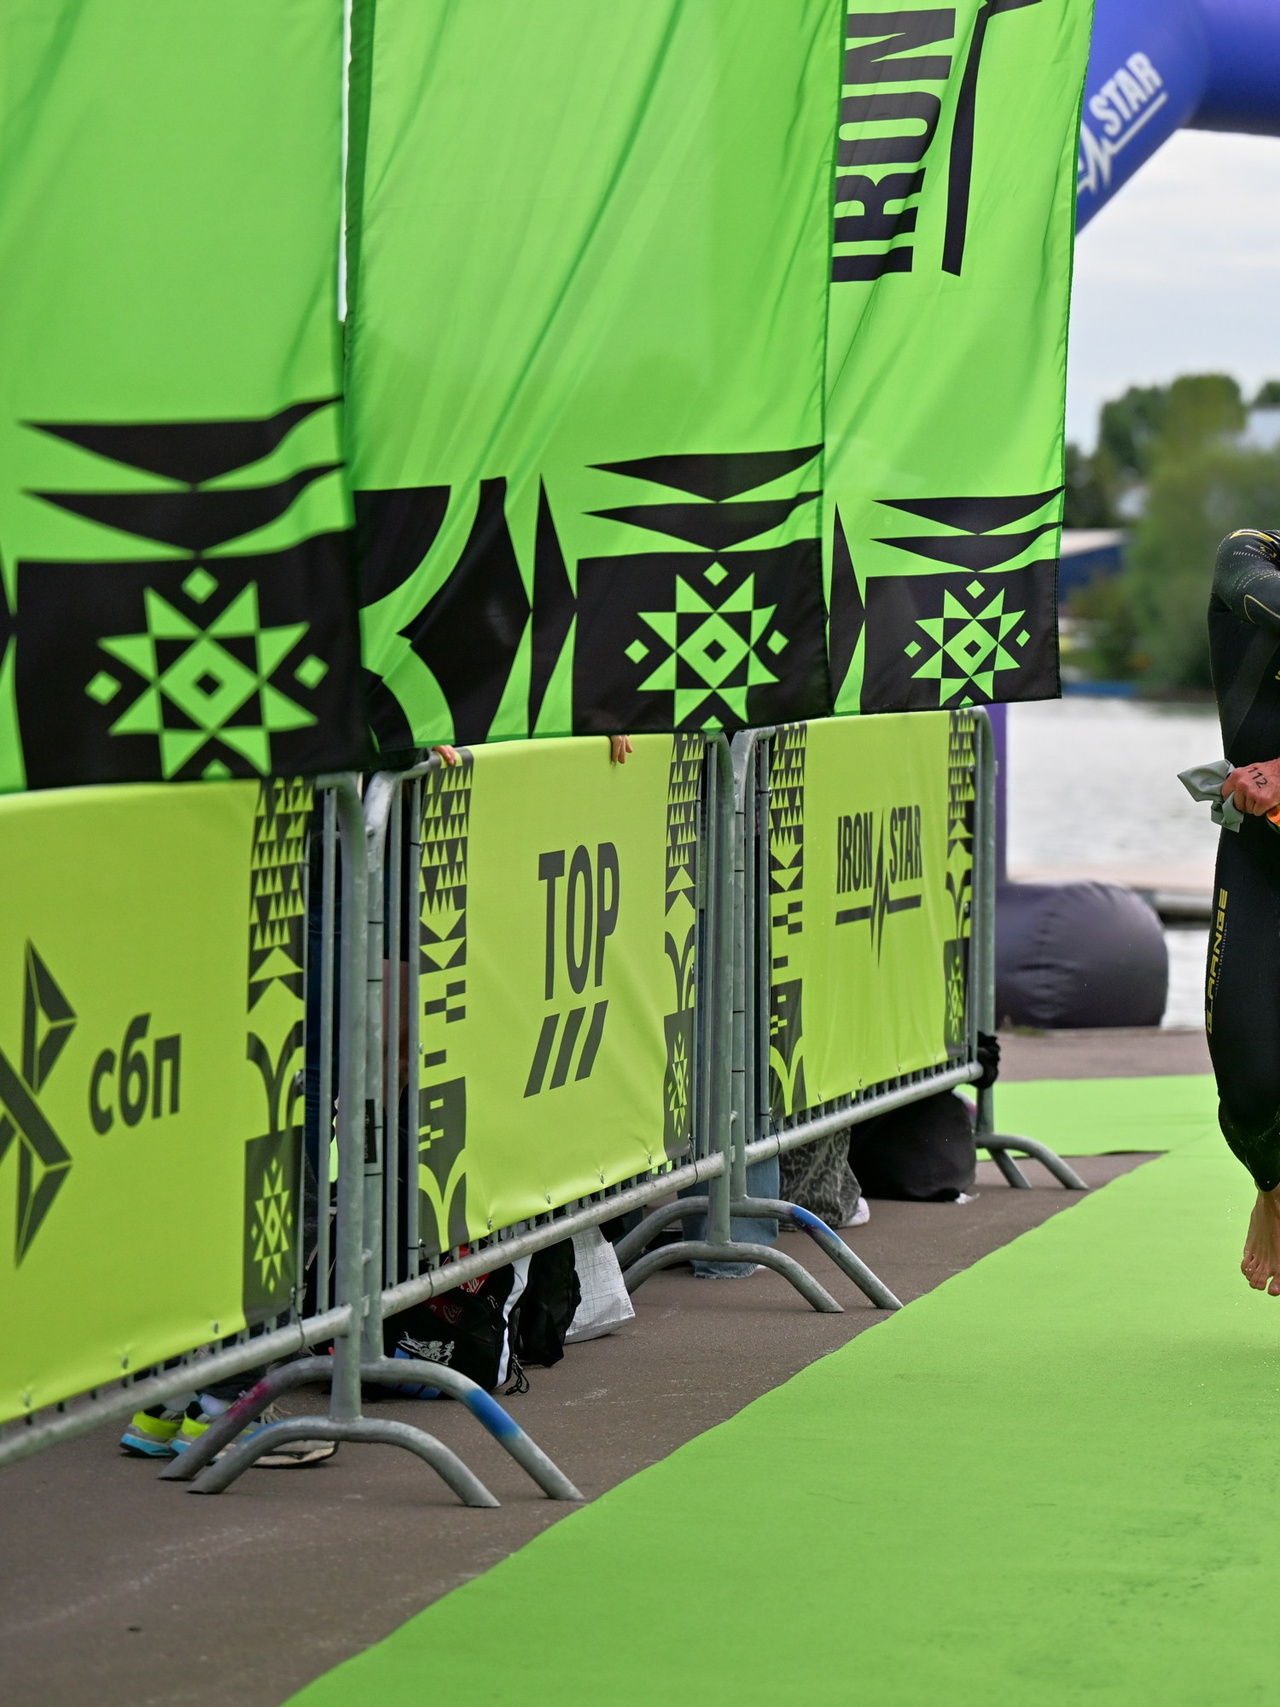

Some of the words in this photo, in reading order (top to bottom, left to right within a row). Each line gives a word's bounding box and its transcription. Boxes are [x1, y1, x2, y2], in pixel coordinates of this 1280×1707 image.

[831, 8, 956, 283] IRON
[1088, 51, 1163, 137] STAR
[1247, 766, 1268, 789] 112
[836, 811, 873, 894] IRON
[889, 804, 923, 884] STAR
[538, 841, 620, 1001] TOP
[88, 1012, 182, 1136] сбп
